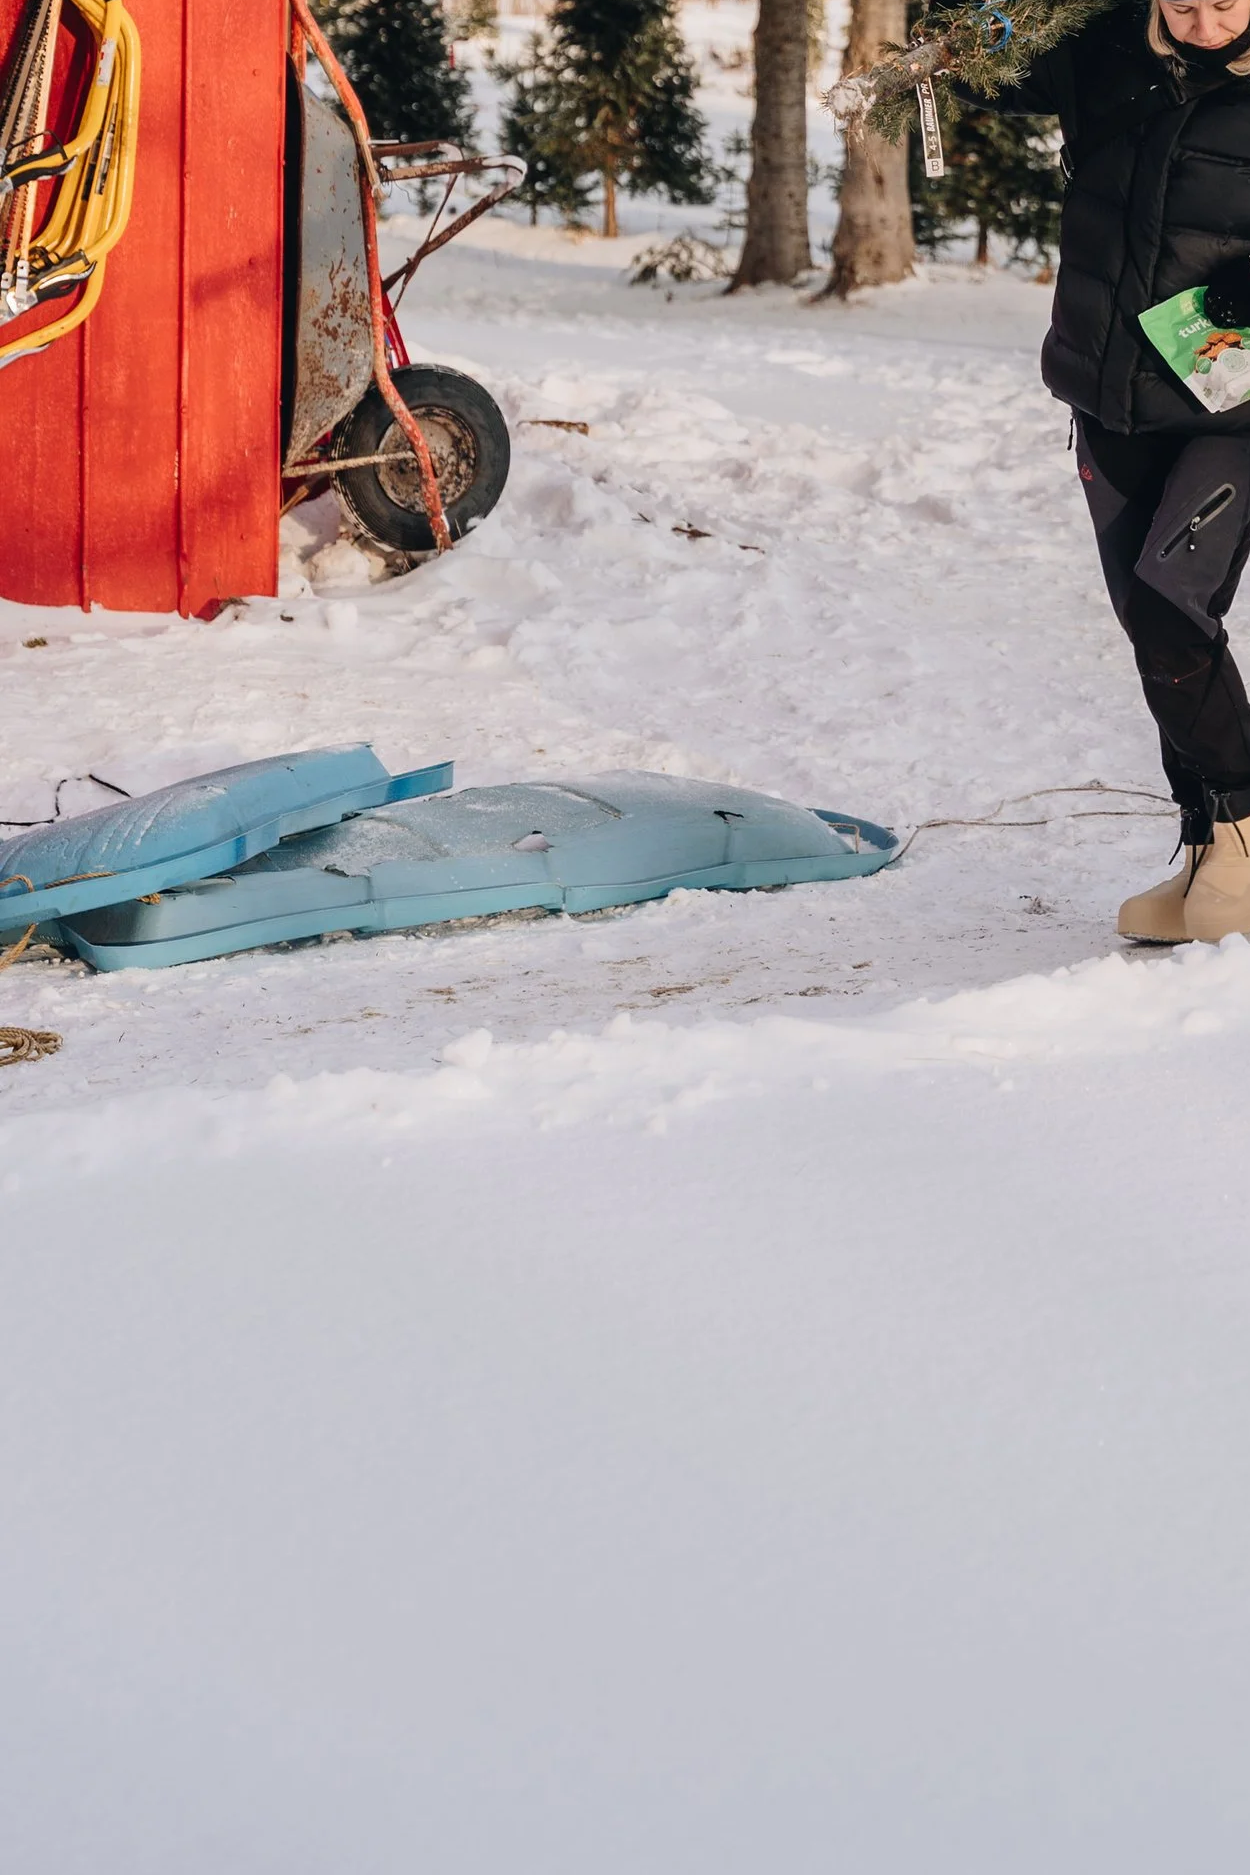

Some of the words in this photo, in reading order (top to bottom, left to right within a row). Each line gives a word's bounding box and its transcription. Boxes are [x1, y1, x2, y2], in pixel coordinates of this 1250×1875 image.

[924, 98, 936, 132] BAUMIER
[932, 160, 940, 172] B
[1178, 318, 1212, 338] turk
